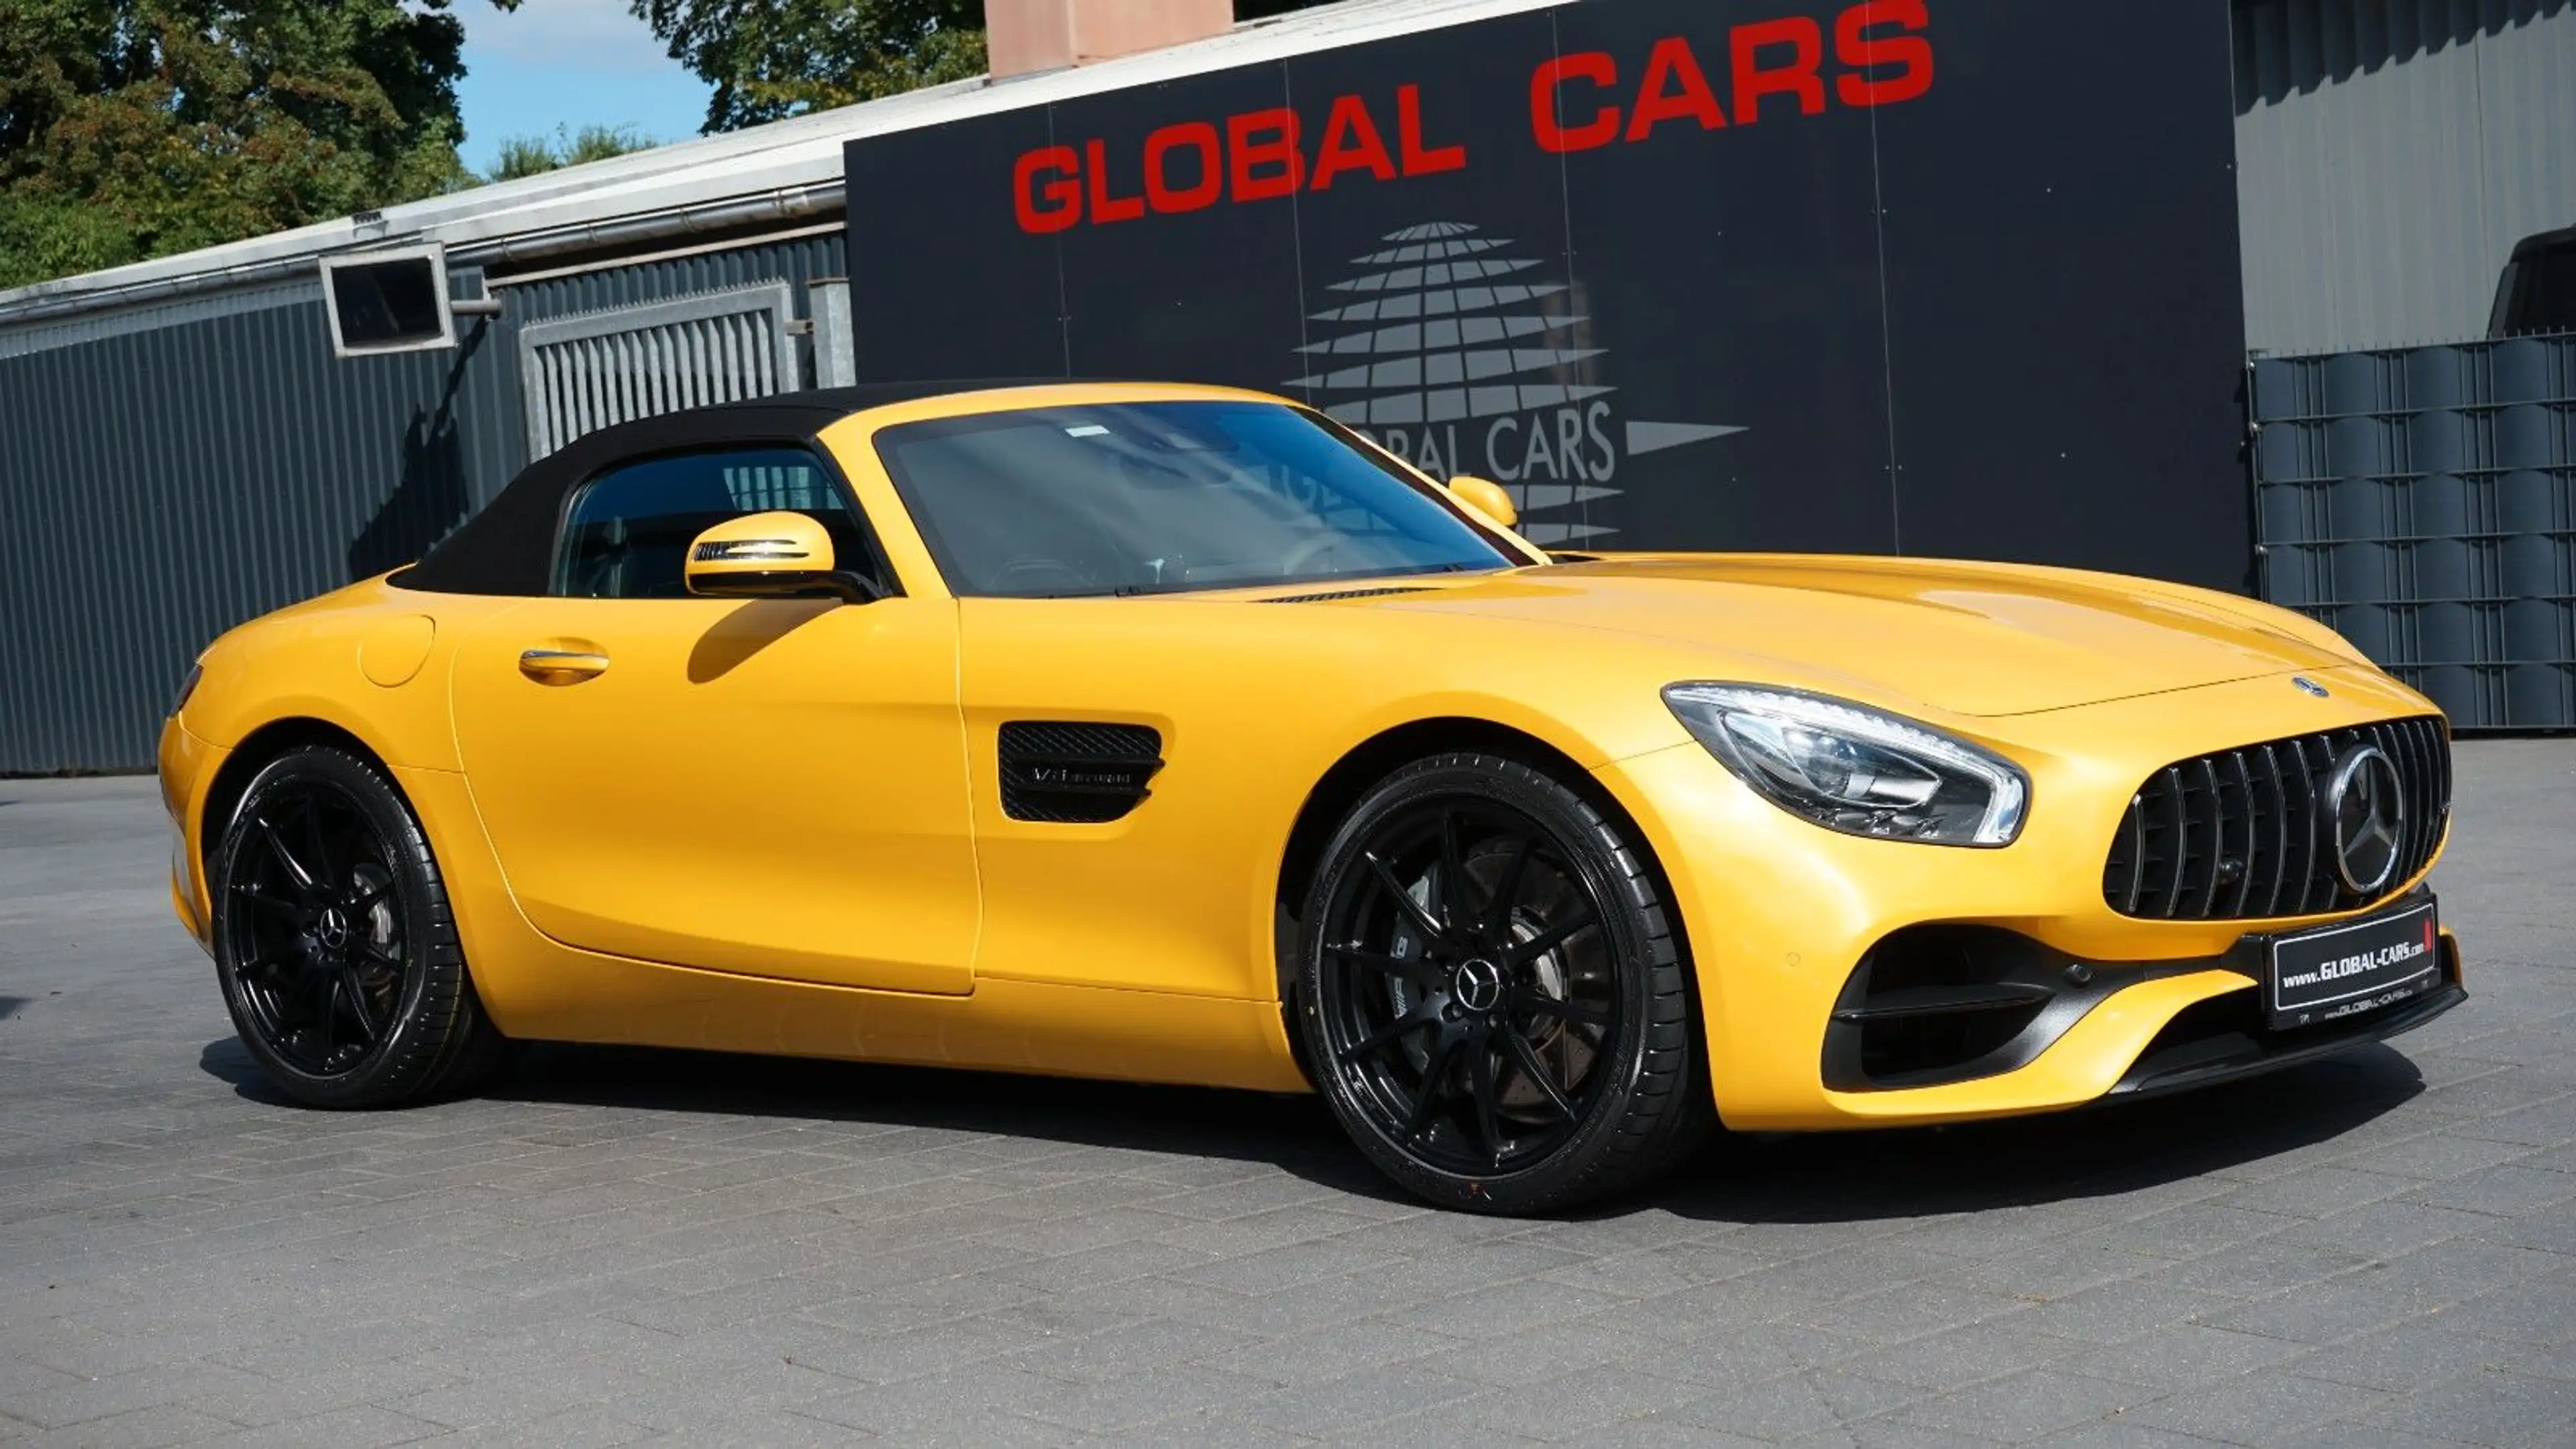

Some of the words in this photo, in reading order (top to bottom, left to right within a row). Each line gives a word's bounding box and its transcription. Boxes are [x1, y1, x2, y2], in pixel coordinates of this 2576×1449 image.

[1014, 85, 1465, 233] GLOBAL
[1531, 0, 1933, 152] CARS
[1486, 400, 1615, 482] CARS
[2283, 941, 2425, 989] www.GLOBAL-CARS.com
